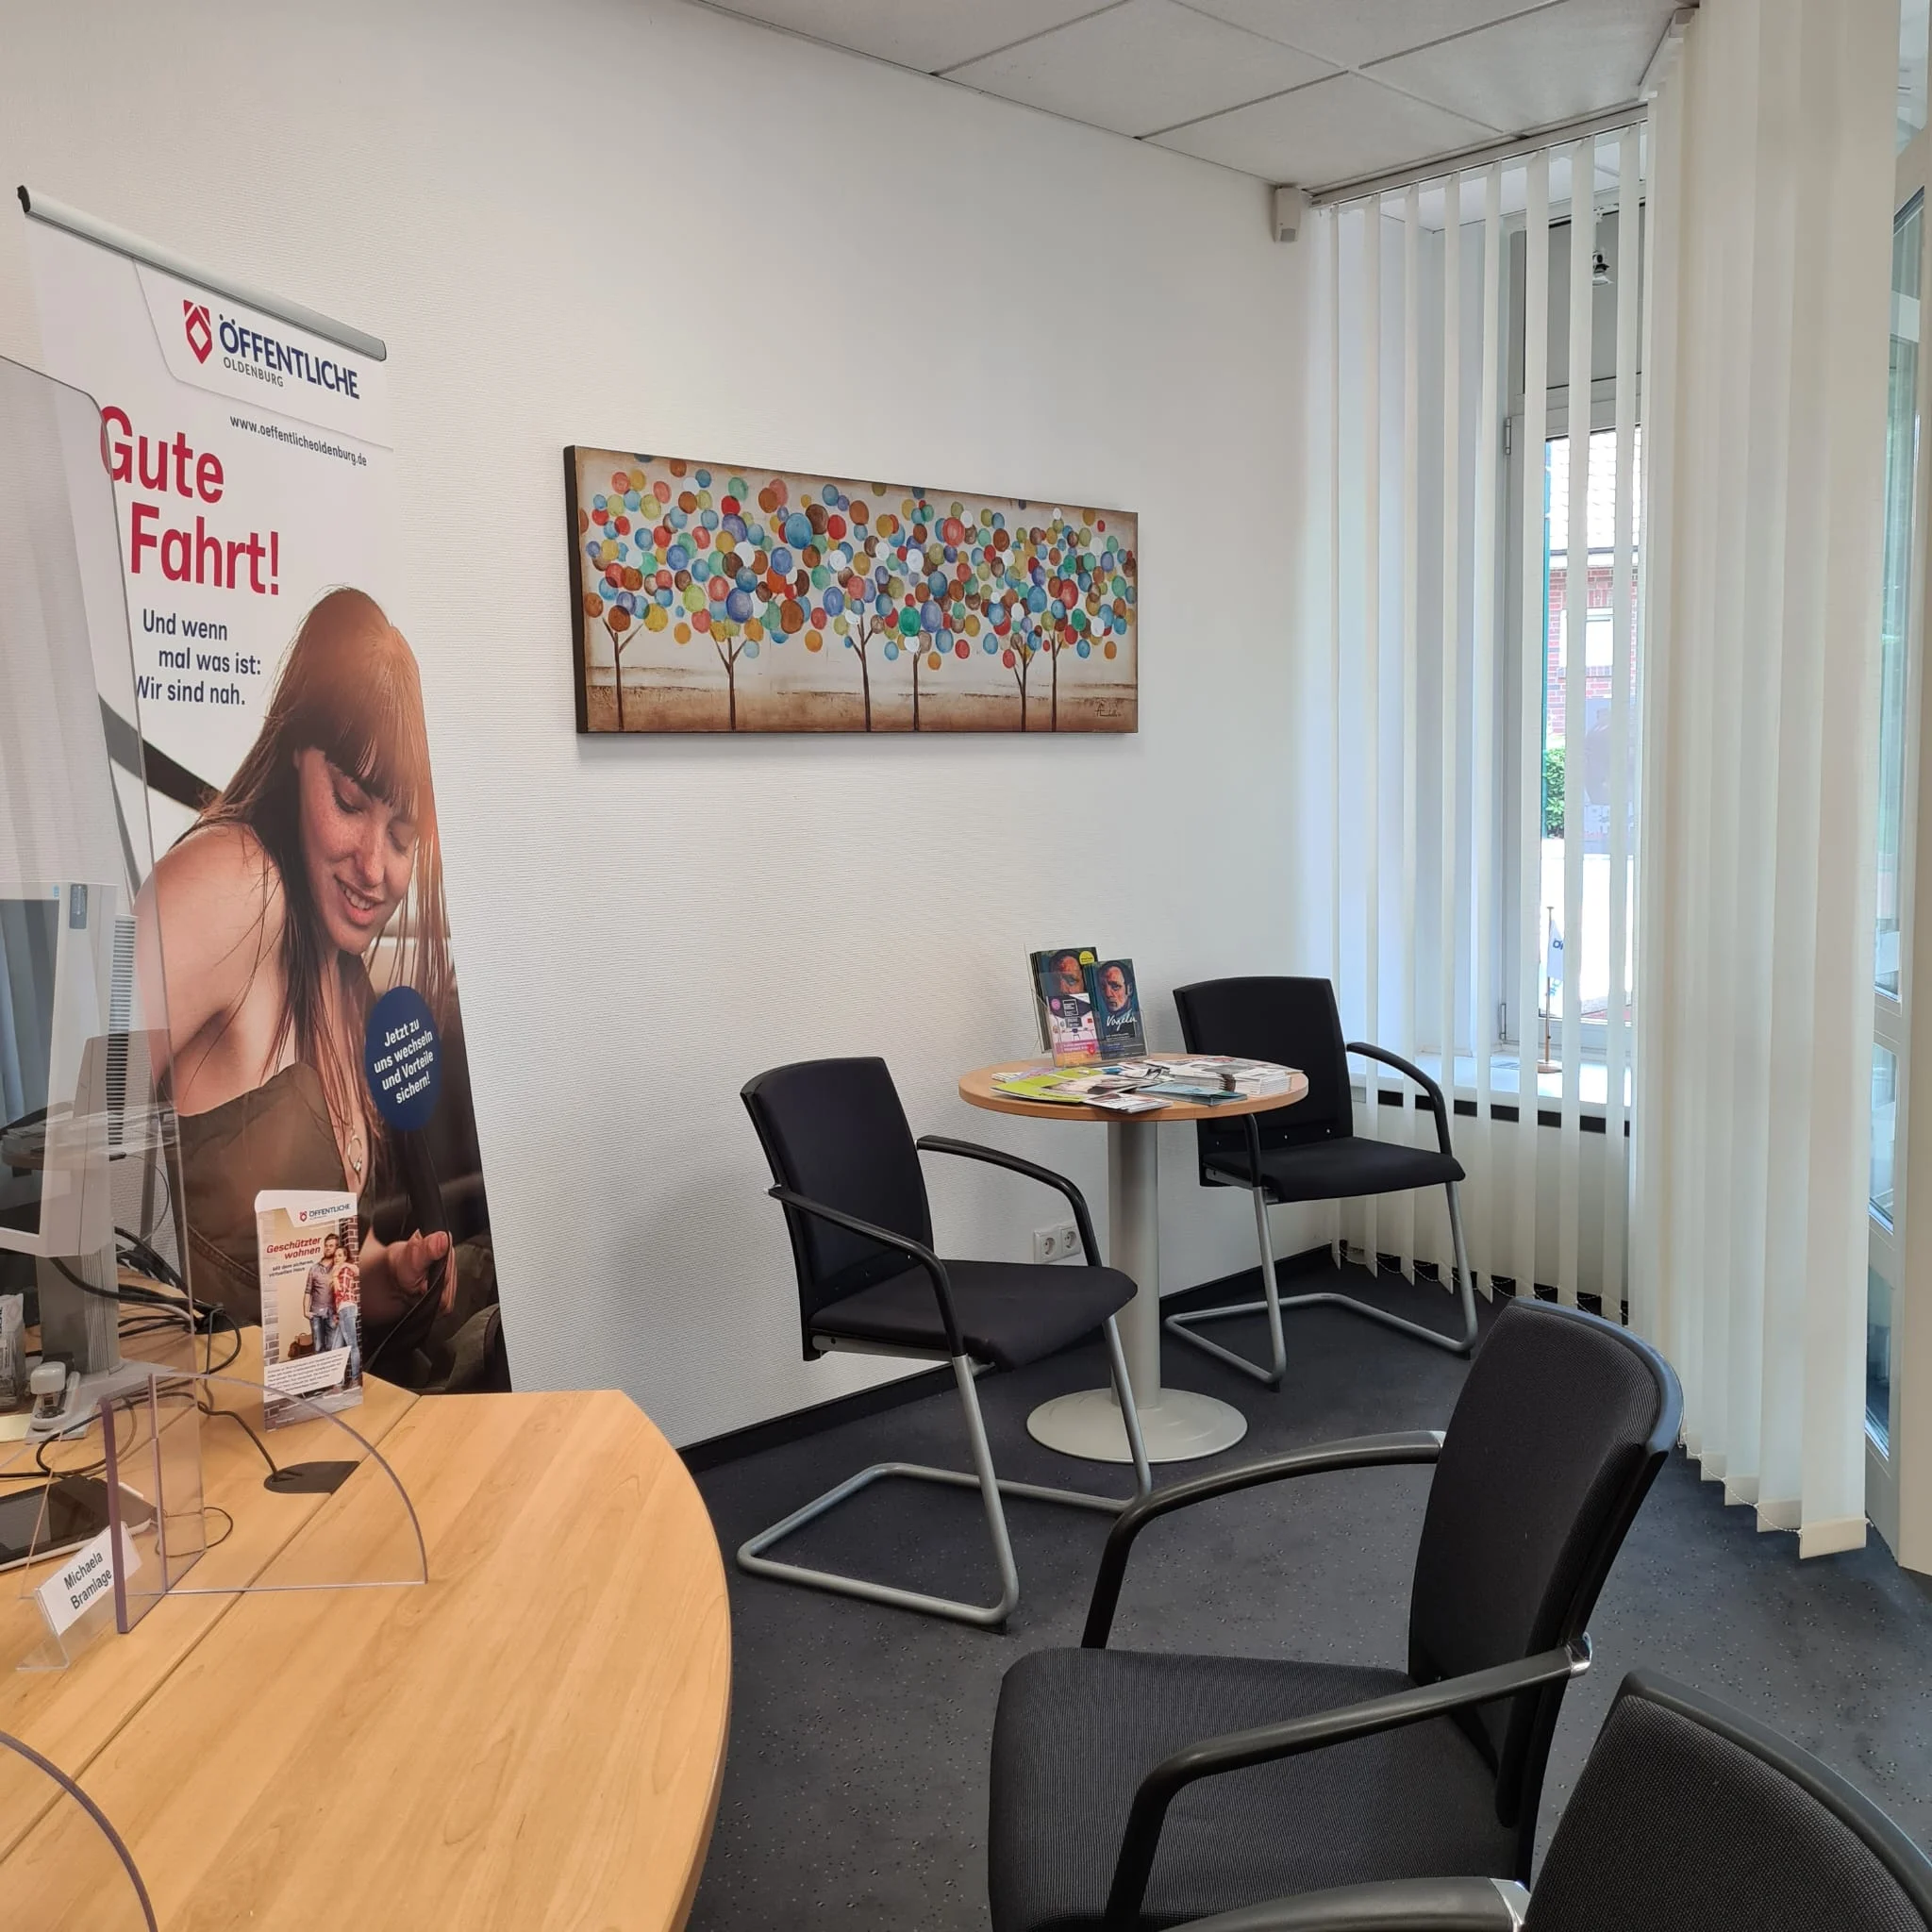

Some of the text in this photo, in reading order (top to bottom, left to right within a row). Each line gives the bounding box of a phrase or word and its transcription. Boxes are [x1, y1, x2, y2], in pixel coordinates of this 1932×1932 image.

[219, 313, 359, 400] ÖFFENTLICHE
[223, 357, 284, 387] OLDENBURG
[100, 406, 224, 504] Gute
[229, 416, 367, 466] www.oeffentlicheoldenburg.de
[131, 502, 279, 595] Fahrt!
[142, 608, 227, 641] Und wenn
[158, 647, 260, 675] mal was ist:
[137, 675, 245, 706] Wir sind nah.
[384, 1018, 420, 1047] Jetzt zu
[374, 1030, 433, 1074] uns wechseln
[381, 1050, 434, 1091] und Vorteile
[395, 1071, 431, 1104] sichern!
[266, 1237, 322, 1254] Geschützter
[284, 1246, 322, 1259] wohnen
[63, 1552, 104, 1591] Michaela
[70, 1569, 112, 1609] Bramlage
